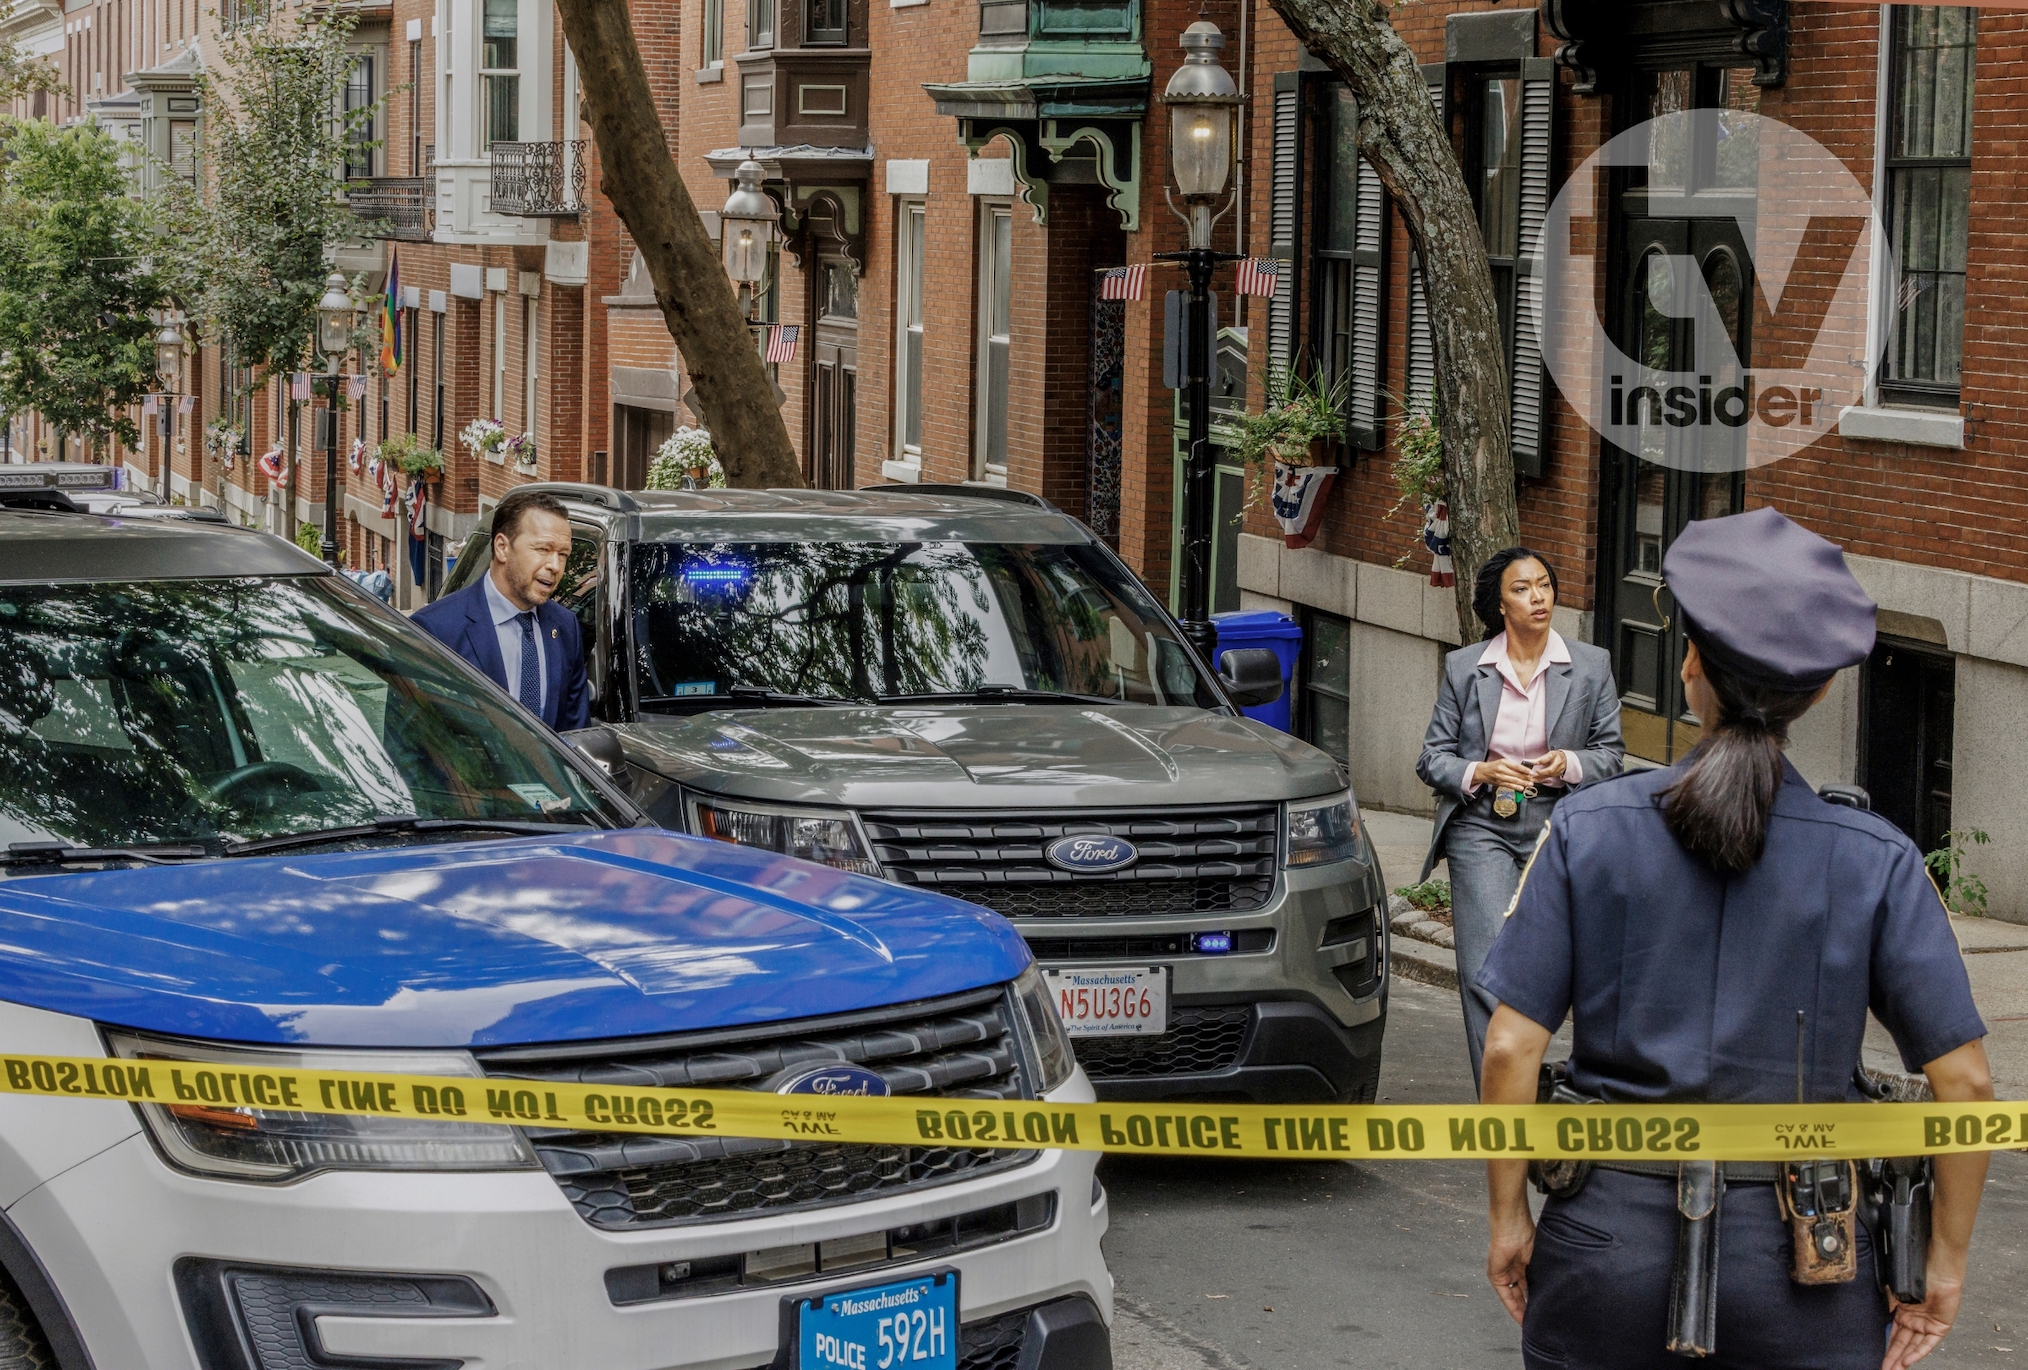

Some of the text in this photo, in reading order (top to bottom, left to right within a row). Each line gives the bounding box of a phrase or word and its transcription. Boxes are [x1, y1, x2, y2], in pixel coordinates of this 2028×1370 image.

[1069, 840, 1118, 861] Ford
[1072, 974, 1136, 985] Massachusetts
[1061, 987, 1151, 1019] N5U3G6
[1083, 1024, 1101, 1032] Spirit
[1102, 1023, 1109, 1031] of
[840, 1288, 919, 1317] Massachusetts
[816, 1306, 946, 1370] POLICE 592H
